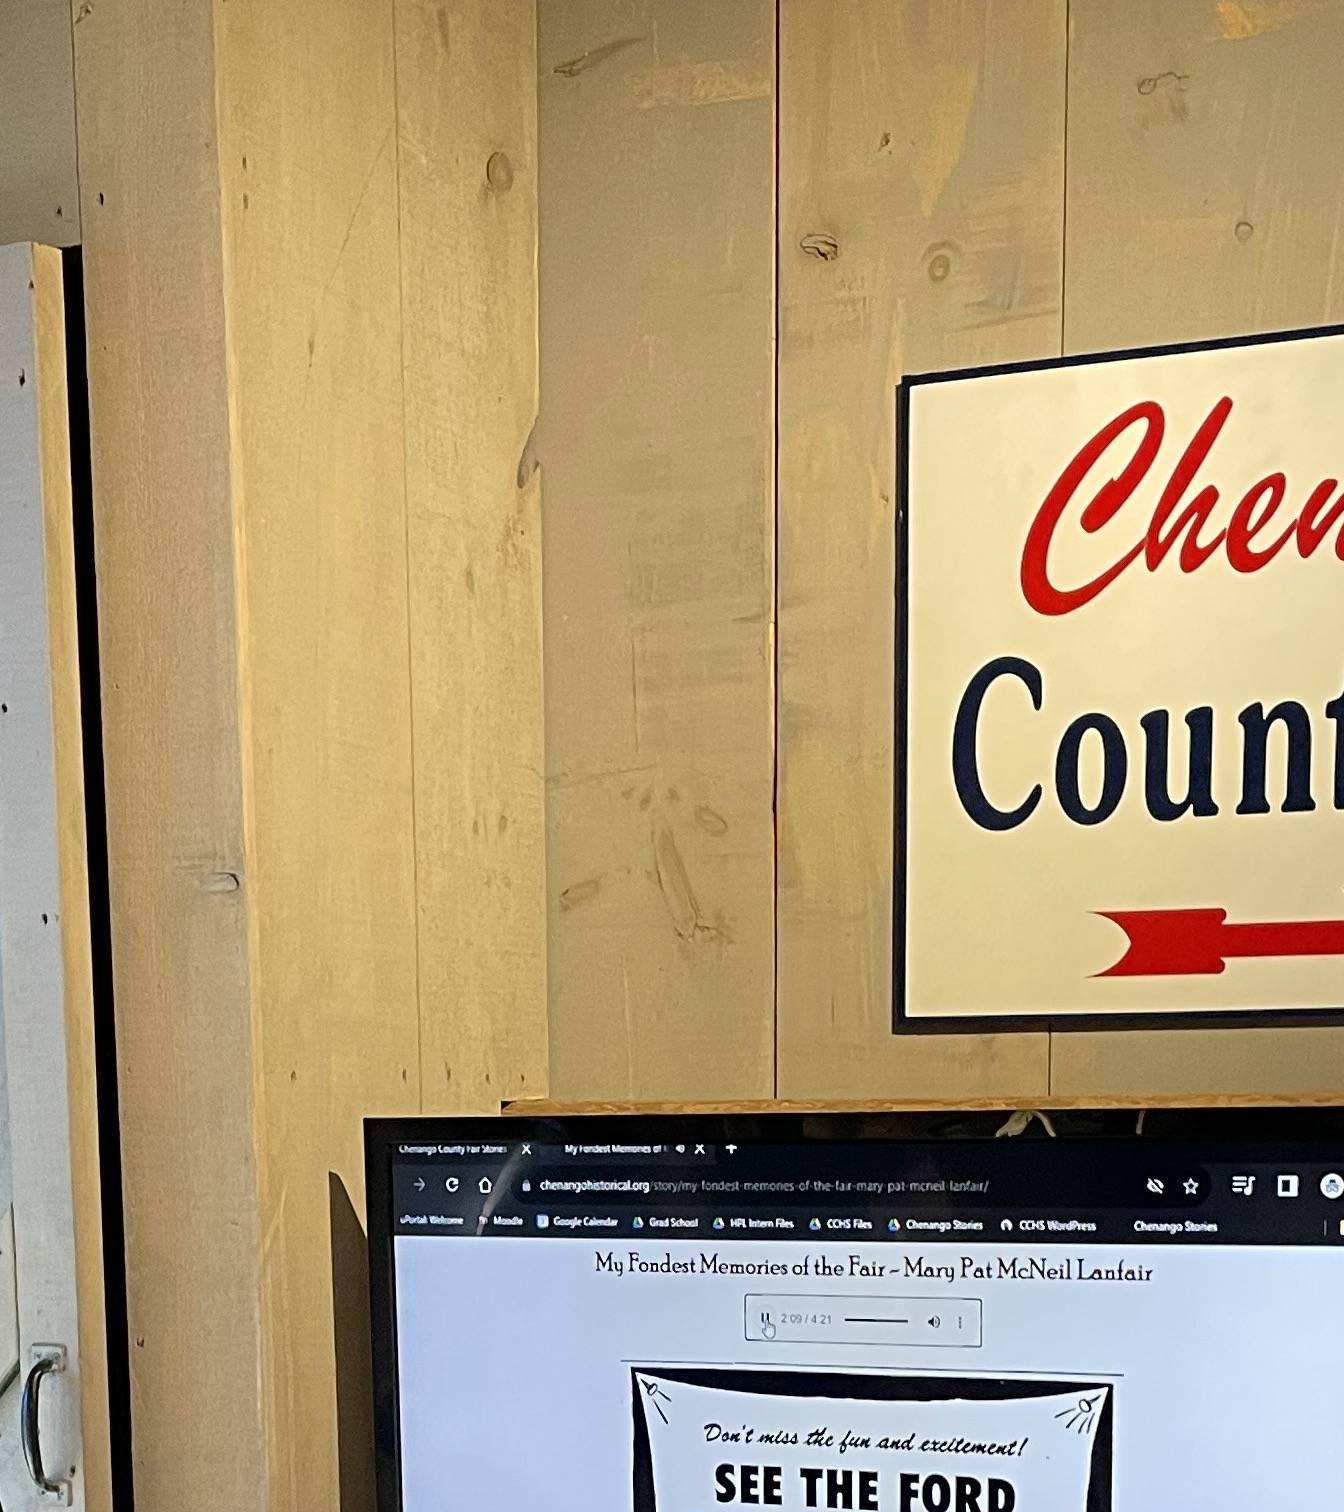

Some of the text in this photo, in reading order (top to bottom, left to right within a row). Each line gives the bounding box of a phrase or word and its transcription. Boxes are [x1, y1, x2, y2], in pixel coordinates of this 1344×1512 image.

[553, 1216, 619, 1229] Google Calendar
[649, 1217, 699, 1228] Grad School
[776, 1218, 795, 1229] Files
[853, 1219, 873, 1230] Files
[906, 1220, 984, 1233] Chenango Stories
[1047, 1220, 1097, 1232] WordPress
[1133, 1220, 1218, 1235] Chenango Stories
[595, 1252, 623, 1277] My
[628, 1252, 696, 1274] Fondest
[700, 1253, 788, 1275] Memories
[792, 1255, 809, 1276] of
[814, 1255, 844, 1276] the
[849, 1255, 885, 1277] Fair
[904, 1256, 955, 1283] Mary
[960, 1257, 993, 1279] Pat
[997, 1257, 1072, 1280] McNeil
[1077, 1258, 1154, 1281] Lanfair
[704, 1423, 1027, 1457] Don't miss the fun and excitement!
[715, 1463, 783, 1505] SEE
[799, 1467, 879, 1511] THE
